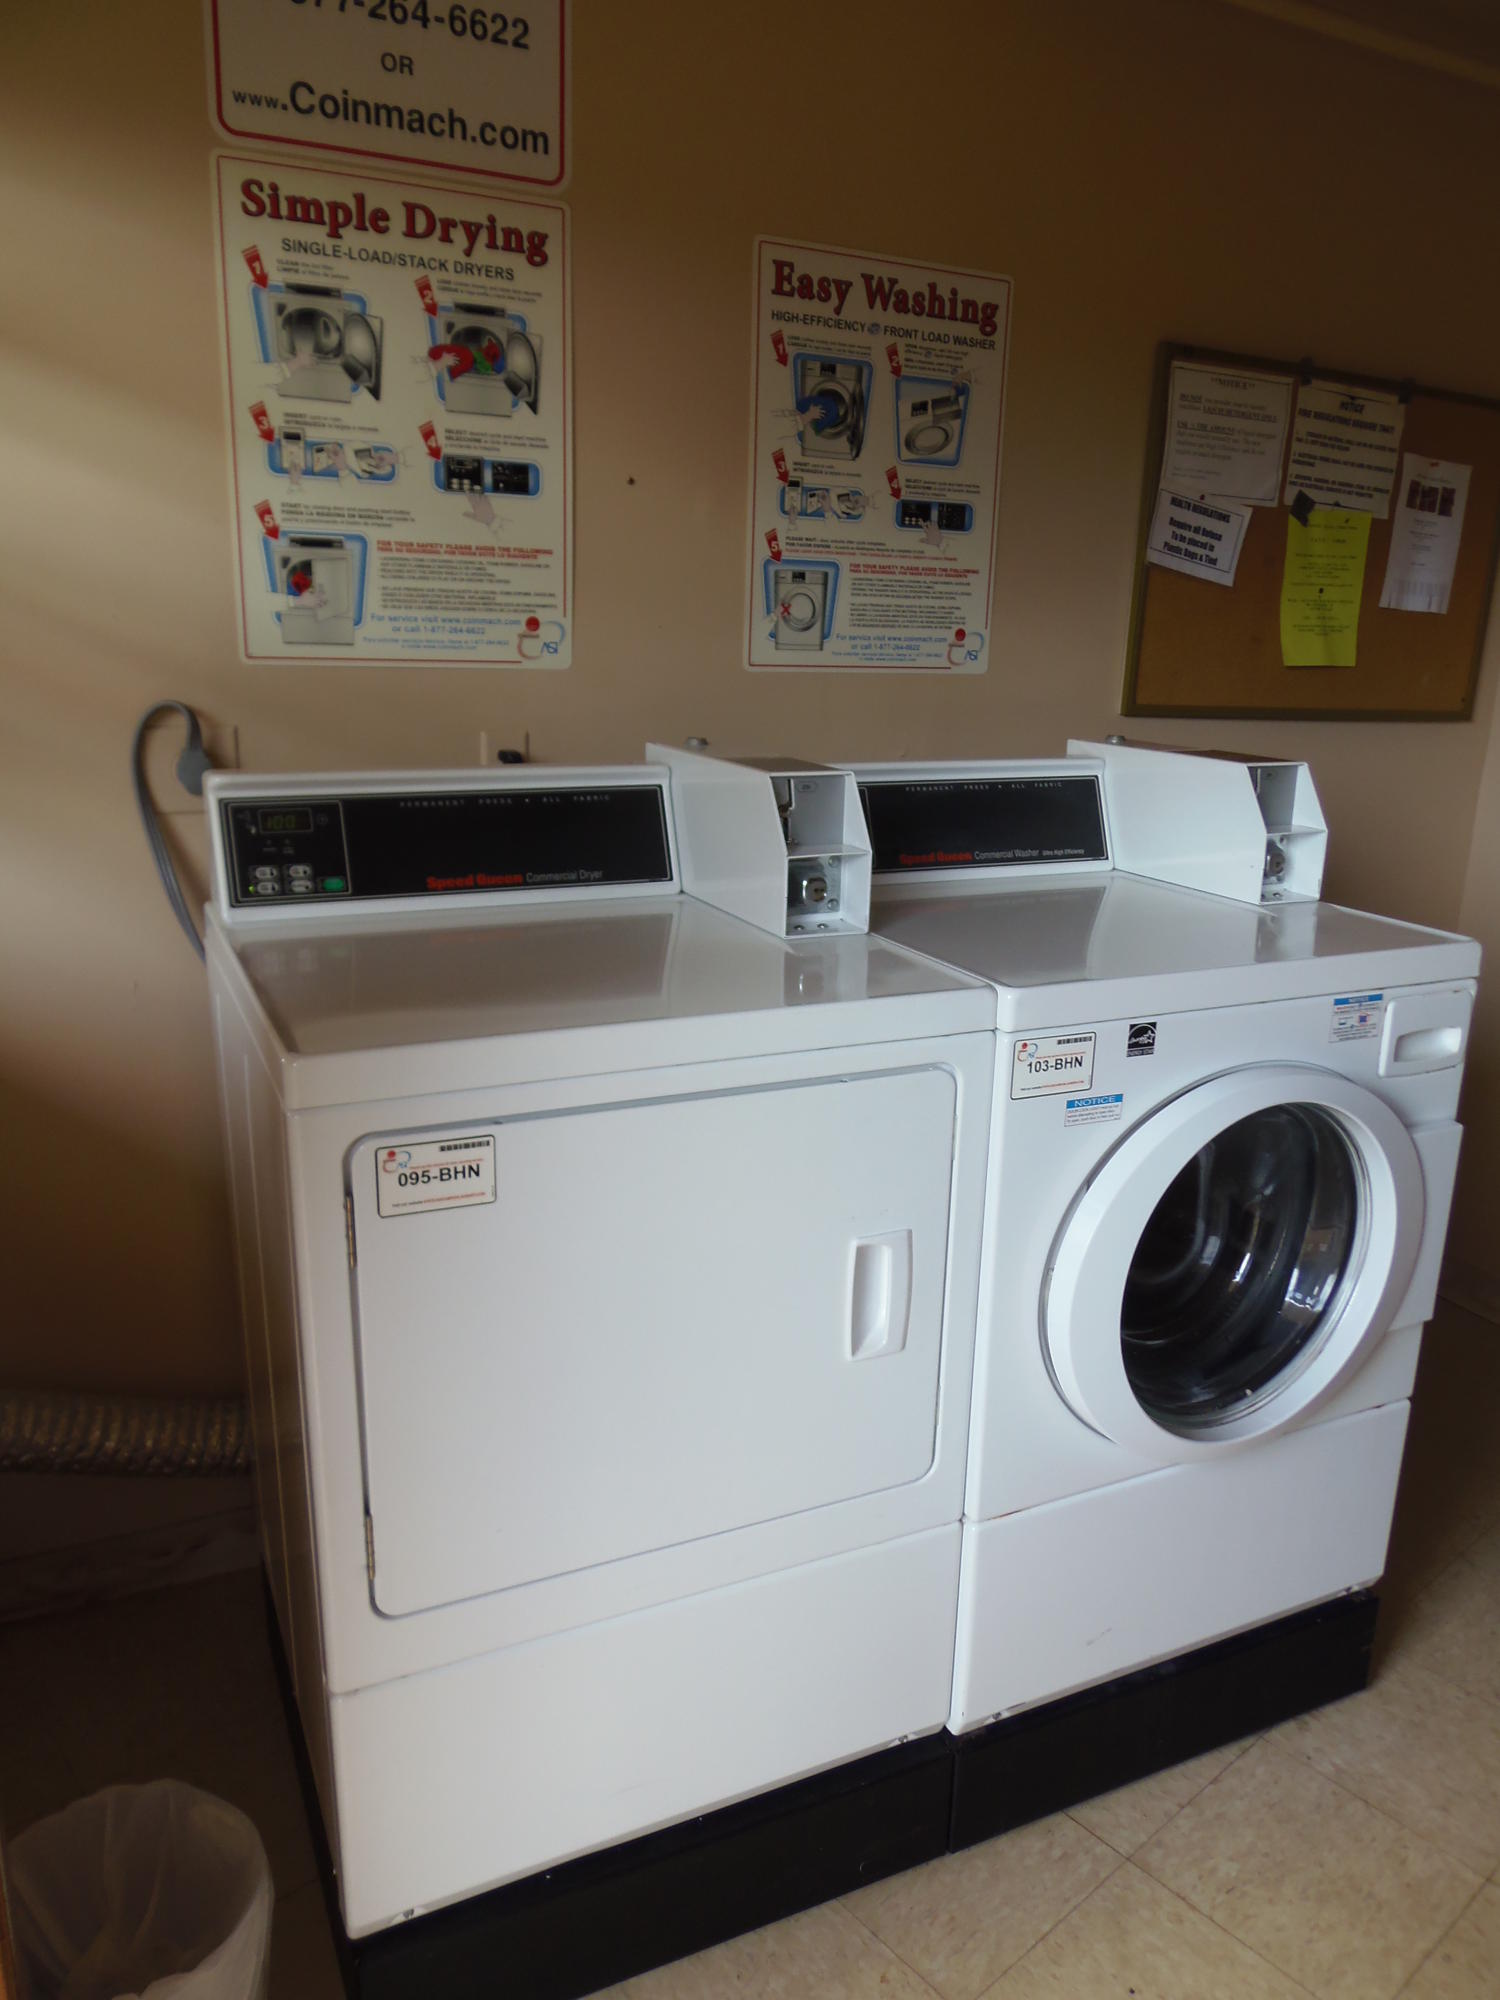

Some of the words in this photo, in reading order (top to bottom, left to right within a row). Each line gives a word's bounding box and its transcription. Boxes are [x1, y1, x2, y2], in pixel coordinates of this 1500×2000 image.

[289, 0, 530, 49] -264-6622
[380, 52, 414, 76] OR
[232, 81, 550, 155] www.Coinmach.com
[240, 178, 391, 239] Simple
[402, 200, 550, 267] Drying
[252, 260, 261, 274] 1
[281, 238, 449, 272] SINGLE-LOAD/STACK
[453, 262, 515, 281] DRYERS
[422, 289, 434, 305] 2
[771, 259, 853, 316] Easy
[860, 273, 999, 337] Washing
[771, 310, 866, 333] HIGH-EFFICIENCY
[883, 325, 919, 340] FRONT
[922, 331, 950, 344] LOAD
[952, 334, 996, 350] WASHER
[777, 343, 786, 355] 1
[258, 416, 270, 430] 3
[777, 460, 786, 472] 3
[263, 514, 275, 528] 5
[1171, 530, 1179, 541] To
[1179, 533, 1186, 543] be
[771, 541, 779, 552] 5
[899, 852, 935, 866] Speed
[974, 849, 1014, 861] Commercial
[1014, 848, 1039, 858] Washer
[426, 874, 474, 891] Speed
[475, 873, 523, 887] Queen
[525, 871, 578, 883] Commercial
[578, 869, 603, 881] Dryer
[1027, 1055, 1084, 1074] 103-BHN
[1074, 1096, 1116, 1107] NOTICE
[398, 1163, 481, 1187] 095-BHN
